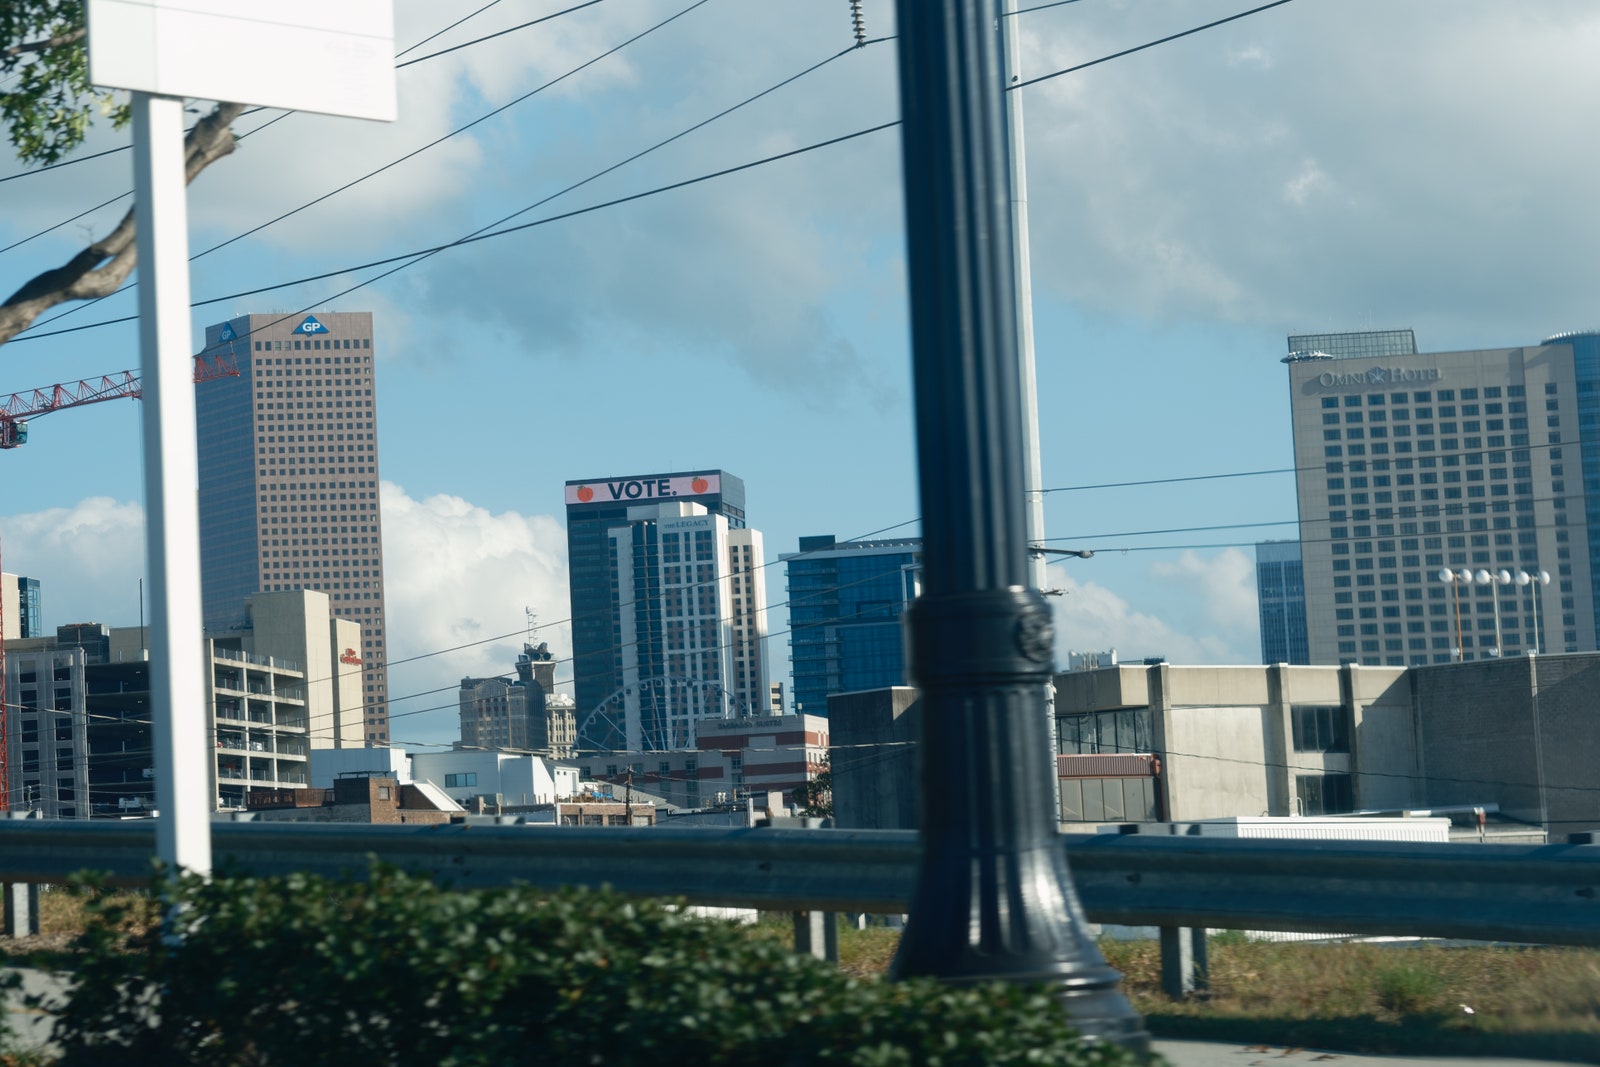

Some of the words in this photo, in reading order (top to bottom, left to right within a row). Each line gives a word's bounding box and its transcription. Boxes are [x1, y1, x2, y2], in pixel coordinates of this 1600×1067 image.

[303, 322, 321, 332] GP
[222, 329, 232, 341] GP
[1320, 371, 1366, 387] OMNI
[608, 479, 677, 499] VOTE.
[676, 520, 708, 528] LEGACY
